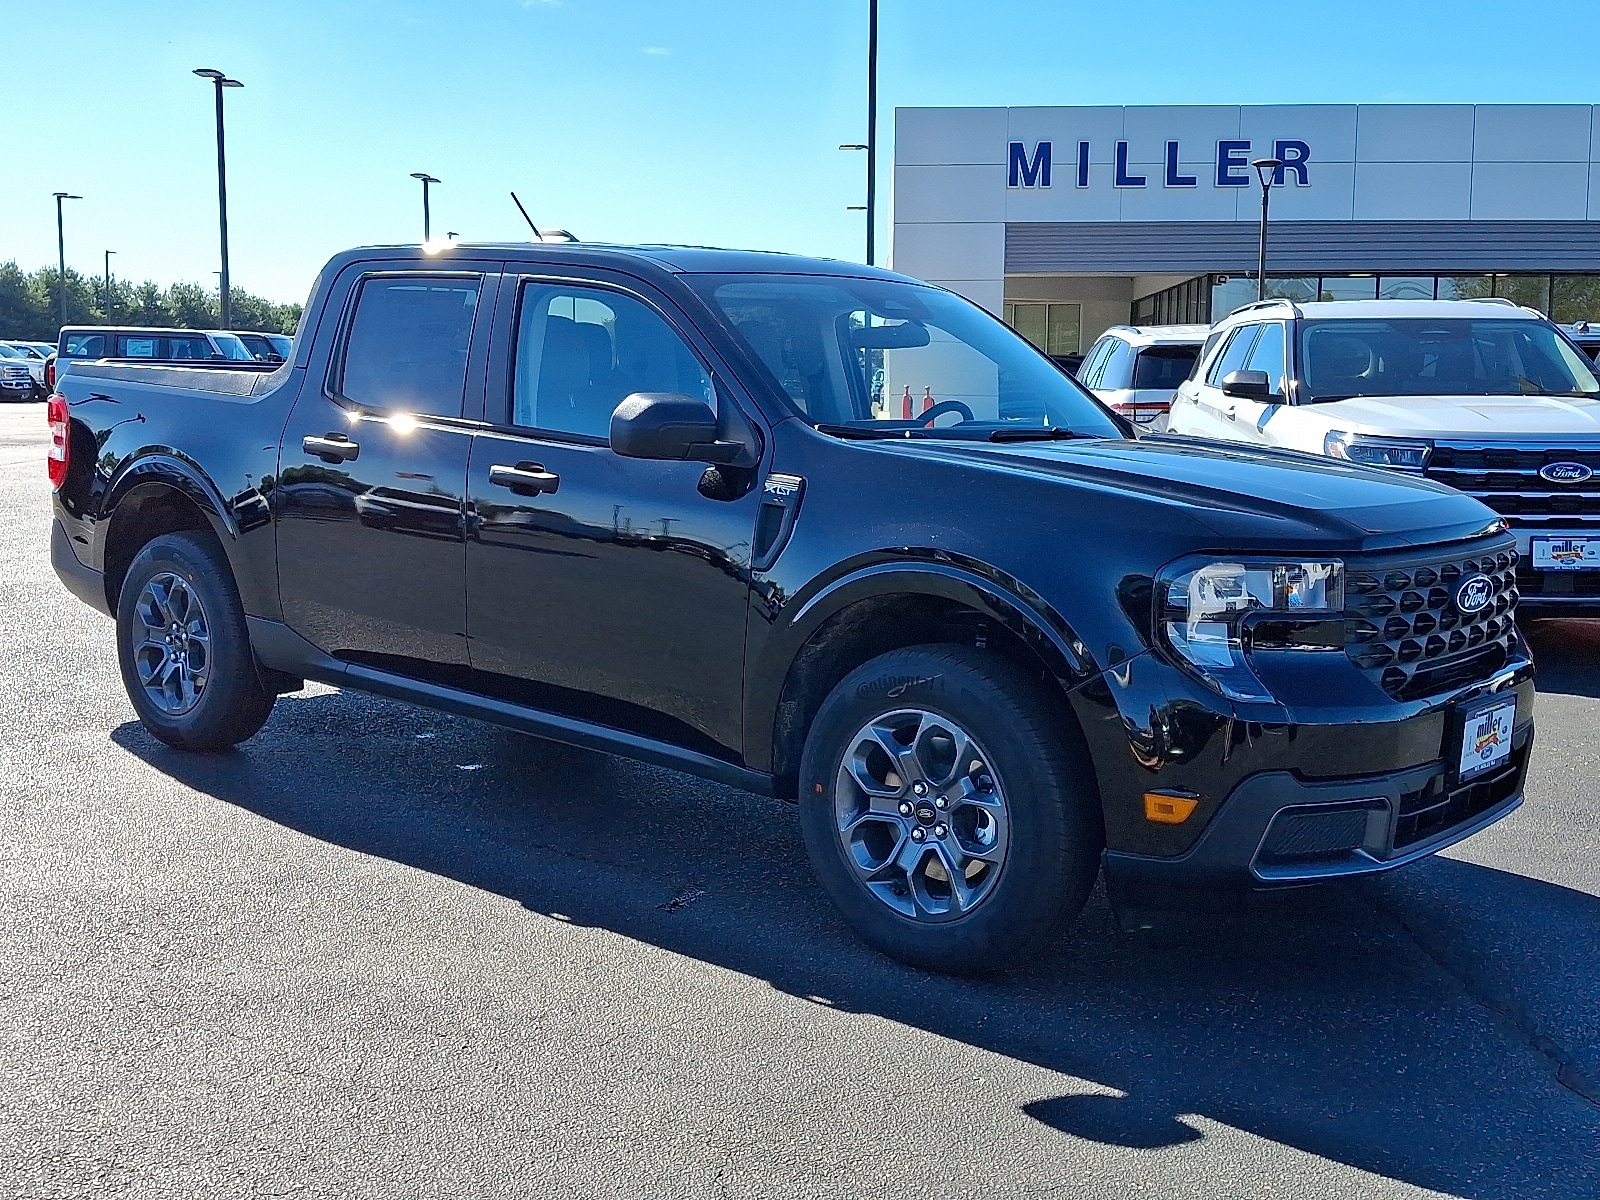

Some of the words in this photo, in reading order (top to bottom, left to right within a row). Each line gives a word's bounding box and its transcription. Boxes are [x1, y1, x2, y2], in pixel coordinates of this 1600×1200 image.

[1007, 138, 1311, 188] MILLER
[1552, 466, 1581, 478] Ford
[764, 483, 799, 496] XLT
[1552, 541, 1586, 552] miller
[1465, 582, 1488, 607] Ford
[1476, 711, 1502, 738] miller
